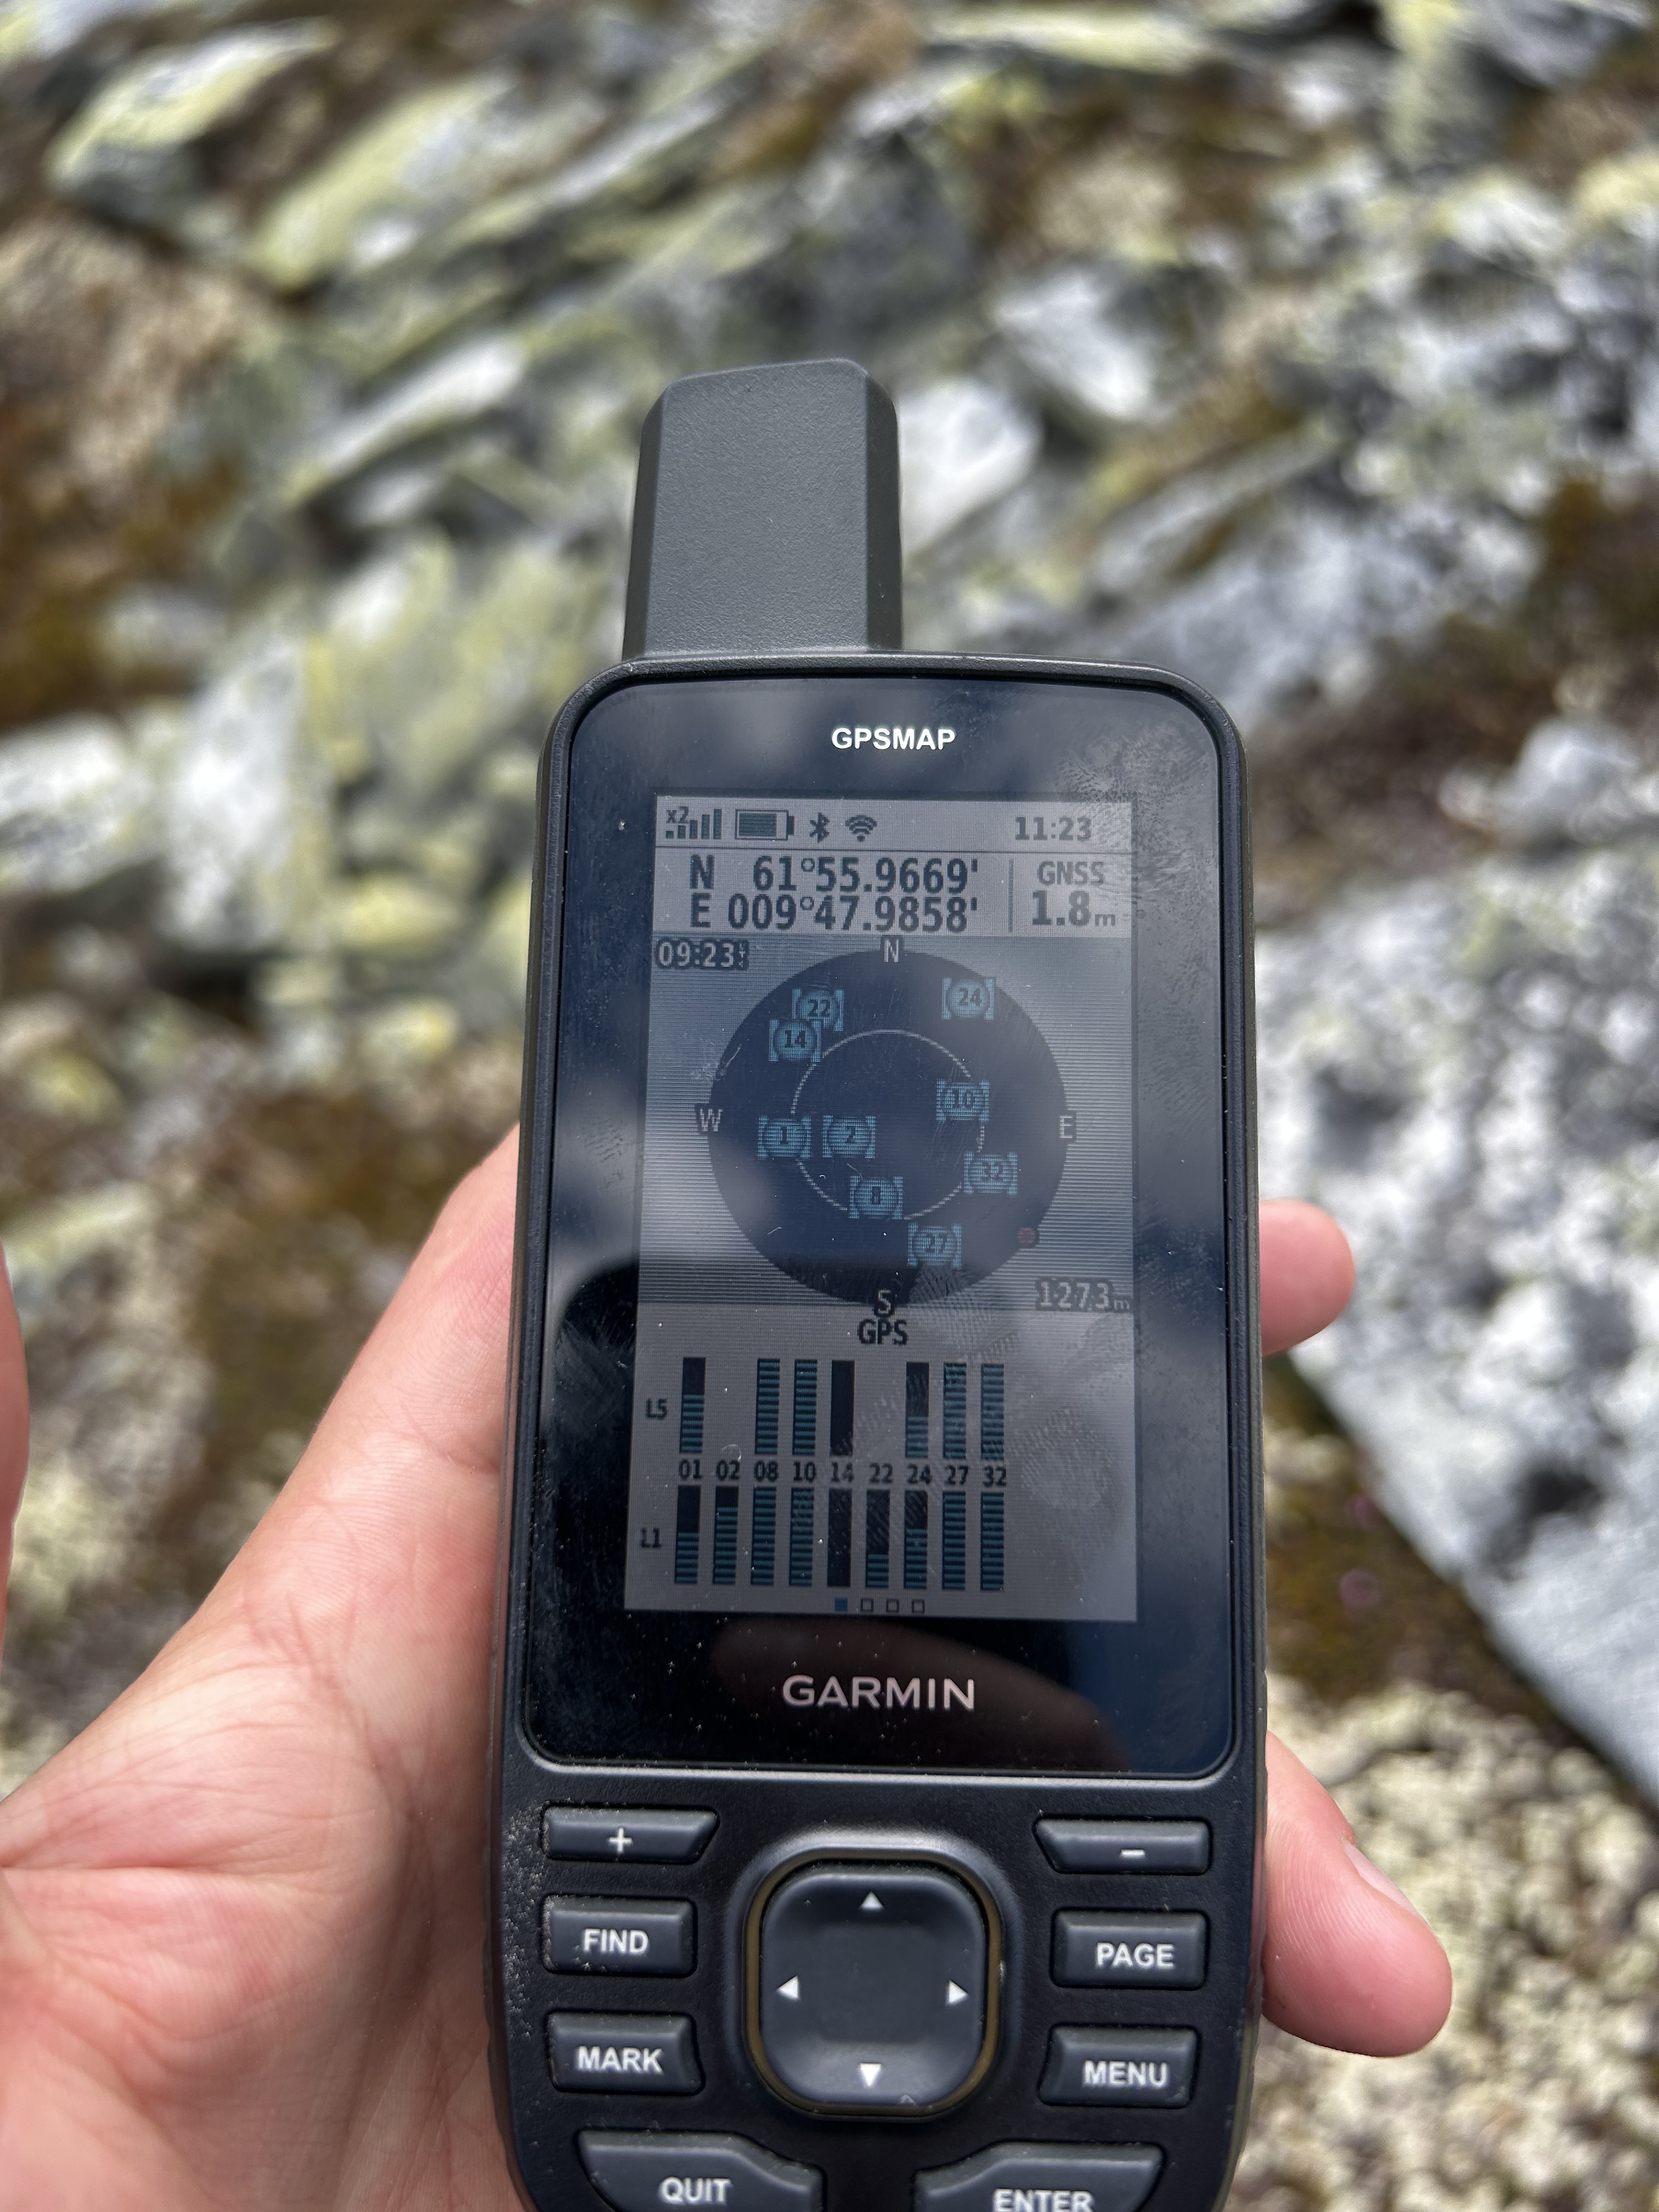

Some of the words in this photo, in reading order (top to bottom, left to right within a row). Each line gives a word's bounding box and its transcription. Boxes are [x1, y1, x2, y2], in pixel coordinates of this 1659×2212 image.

[831, 726, 956, 751] GPSMAP
[1015, 816, 1092, 842] 11:23
[1037, 861, 1104, 886] GNSS
[884, 939, 899, 962] N
[808, 1000, 831, 1017] 22
[958, 990, 982, 1006] 24
[784, 1030, 807, 1048] 14
[699, 1108, 723, 1131] W
[1059, 1117, 1073, 1139] E
[877, 1290, 892, 1313] S
[857, 1319, 909, 1345] GPS
[646, 1399, 668, 1419] L5
[679, 1459, 702, 1480] 01
[716, 1460, 740, 1481] 02
[754, 1460, 778, 1482] 08
[793, 1462, 816, 1482] 10
[830, 1462, 854, 1483] 14
[906, 1464, 932, 1485] 24
[944, 1464, 969, 1485] 27
[983, 1465, 1007, 1486] 32
[782, 1675, 975, 1711] GARMIN
[582, 1929, 650, 1955] FIND
[1096, 1943, 1175, 1970] PAGE
[577, 2046, 662, 2073] MARK
[1083, 2061, 1169, 2087] MENU
[661, 2178, 730, 2205] QUIT
[994, 2188, 1093, 2212] ENTER
